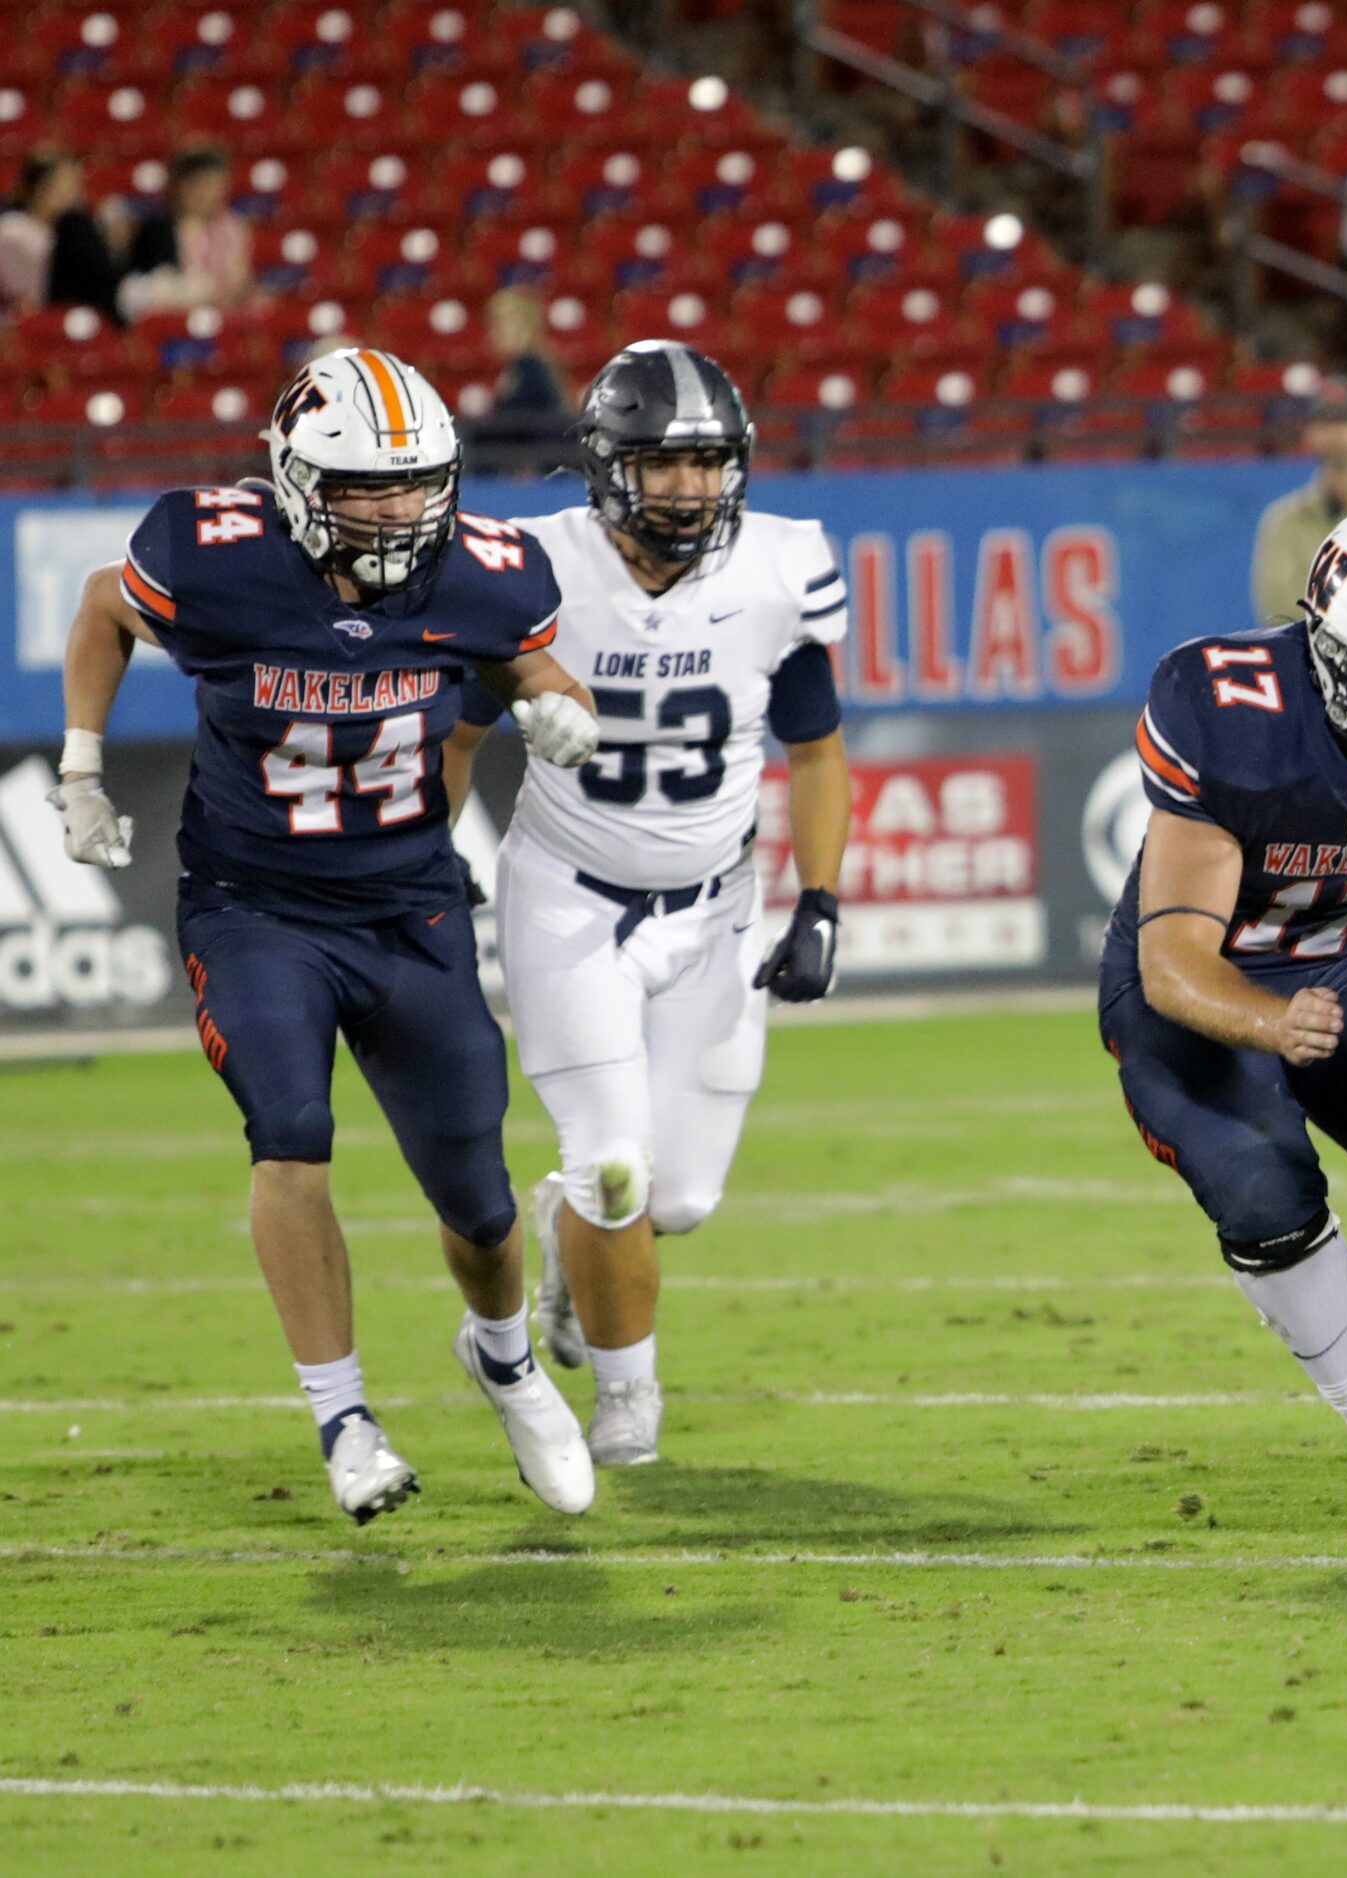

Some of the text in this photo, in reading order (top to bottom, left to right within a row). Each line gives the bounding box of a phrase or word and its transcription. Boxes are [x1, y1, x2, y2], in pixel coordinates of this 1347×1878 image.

[389, 455, 418, 466] TEAM
[195, 488, 263, 546] 44
[253, 662, 441, 715] WAKELAND
[592, 648, 712, 678] LONE STAR
[1203, 645, 1285, 712] 17
[260, 710, 426, 835] 44
[578, 682, 733, 808] 53
